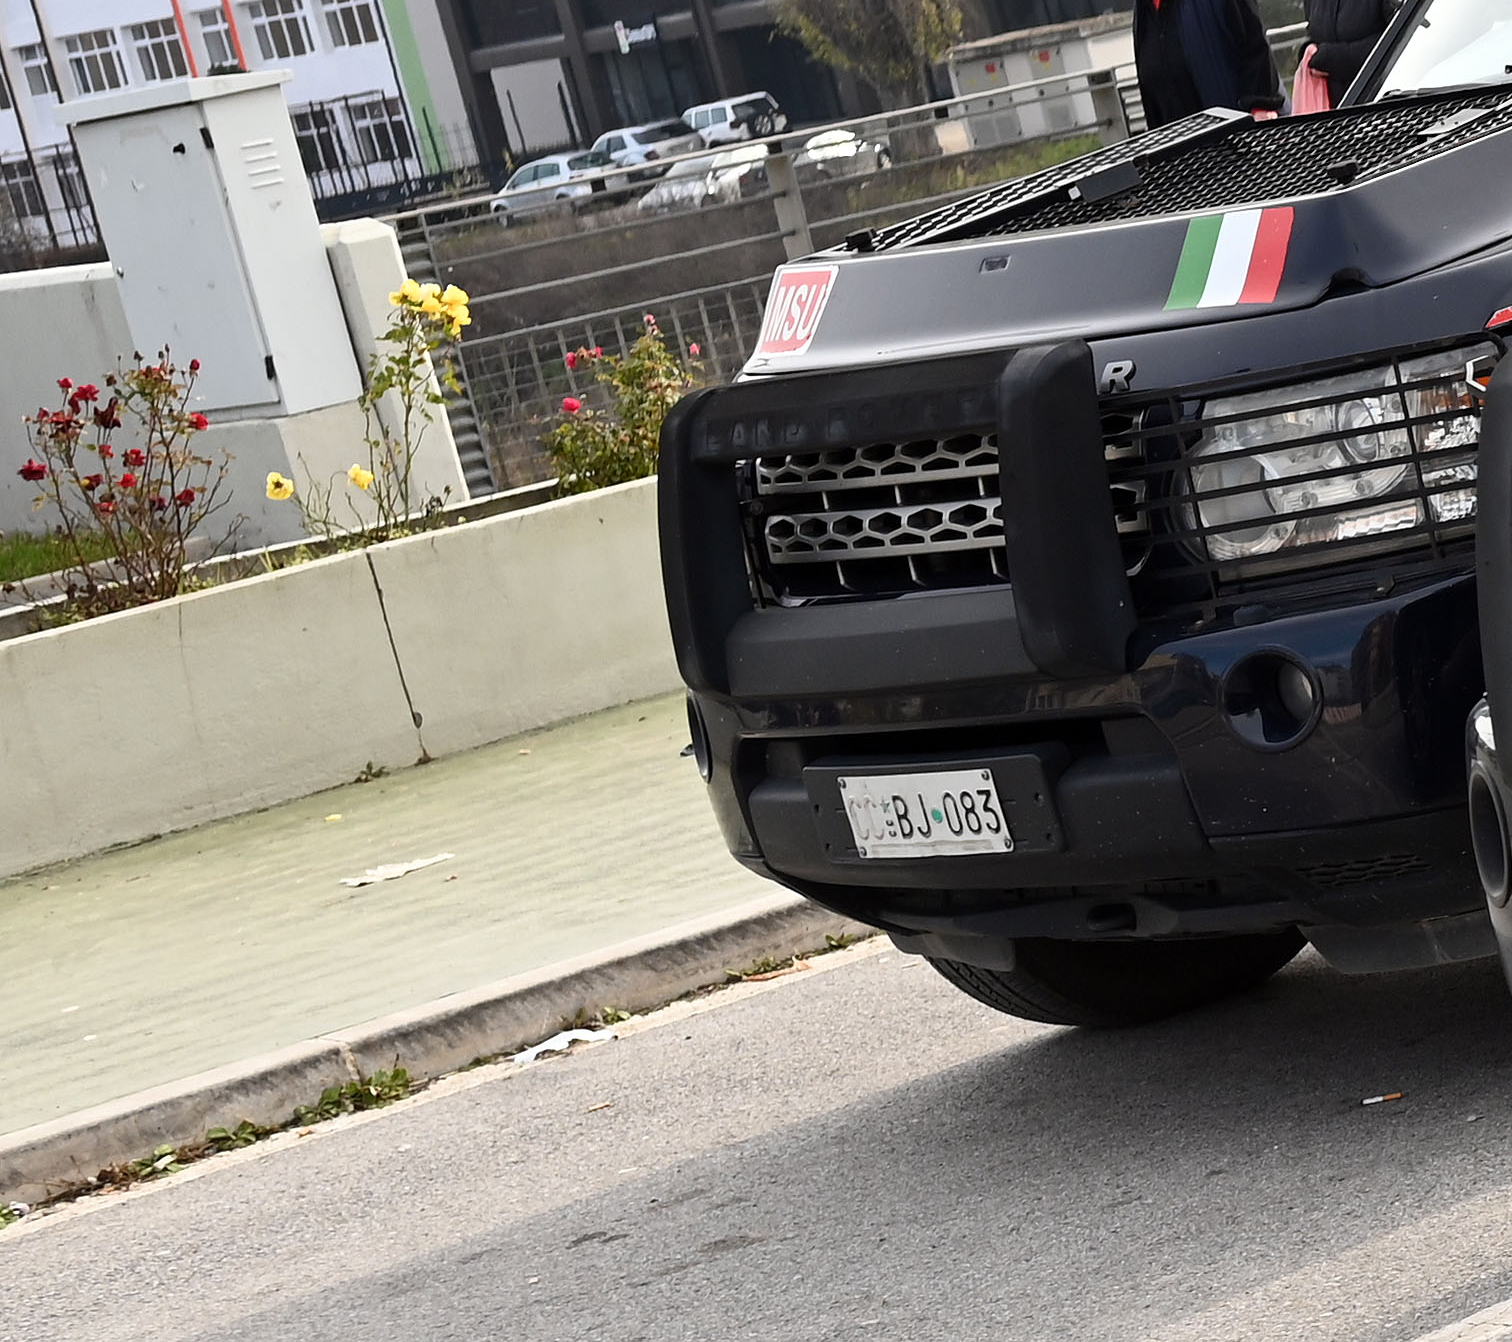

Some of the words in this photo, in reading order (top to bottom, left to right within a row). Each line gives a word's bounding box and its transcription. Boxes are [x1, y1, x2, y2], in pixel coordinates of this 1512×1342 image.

[763, 283, 828, 343] MSU
[892, 793, 932, 840] BJ
[942, 789, 1001, 836] 083
